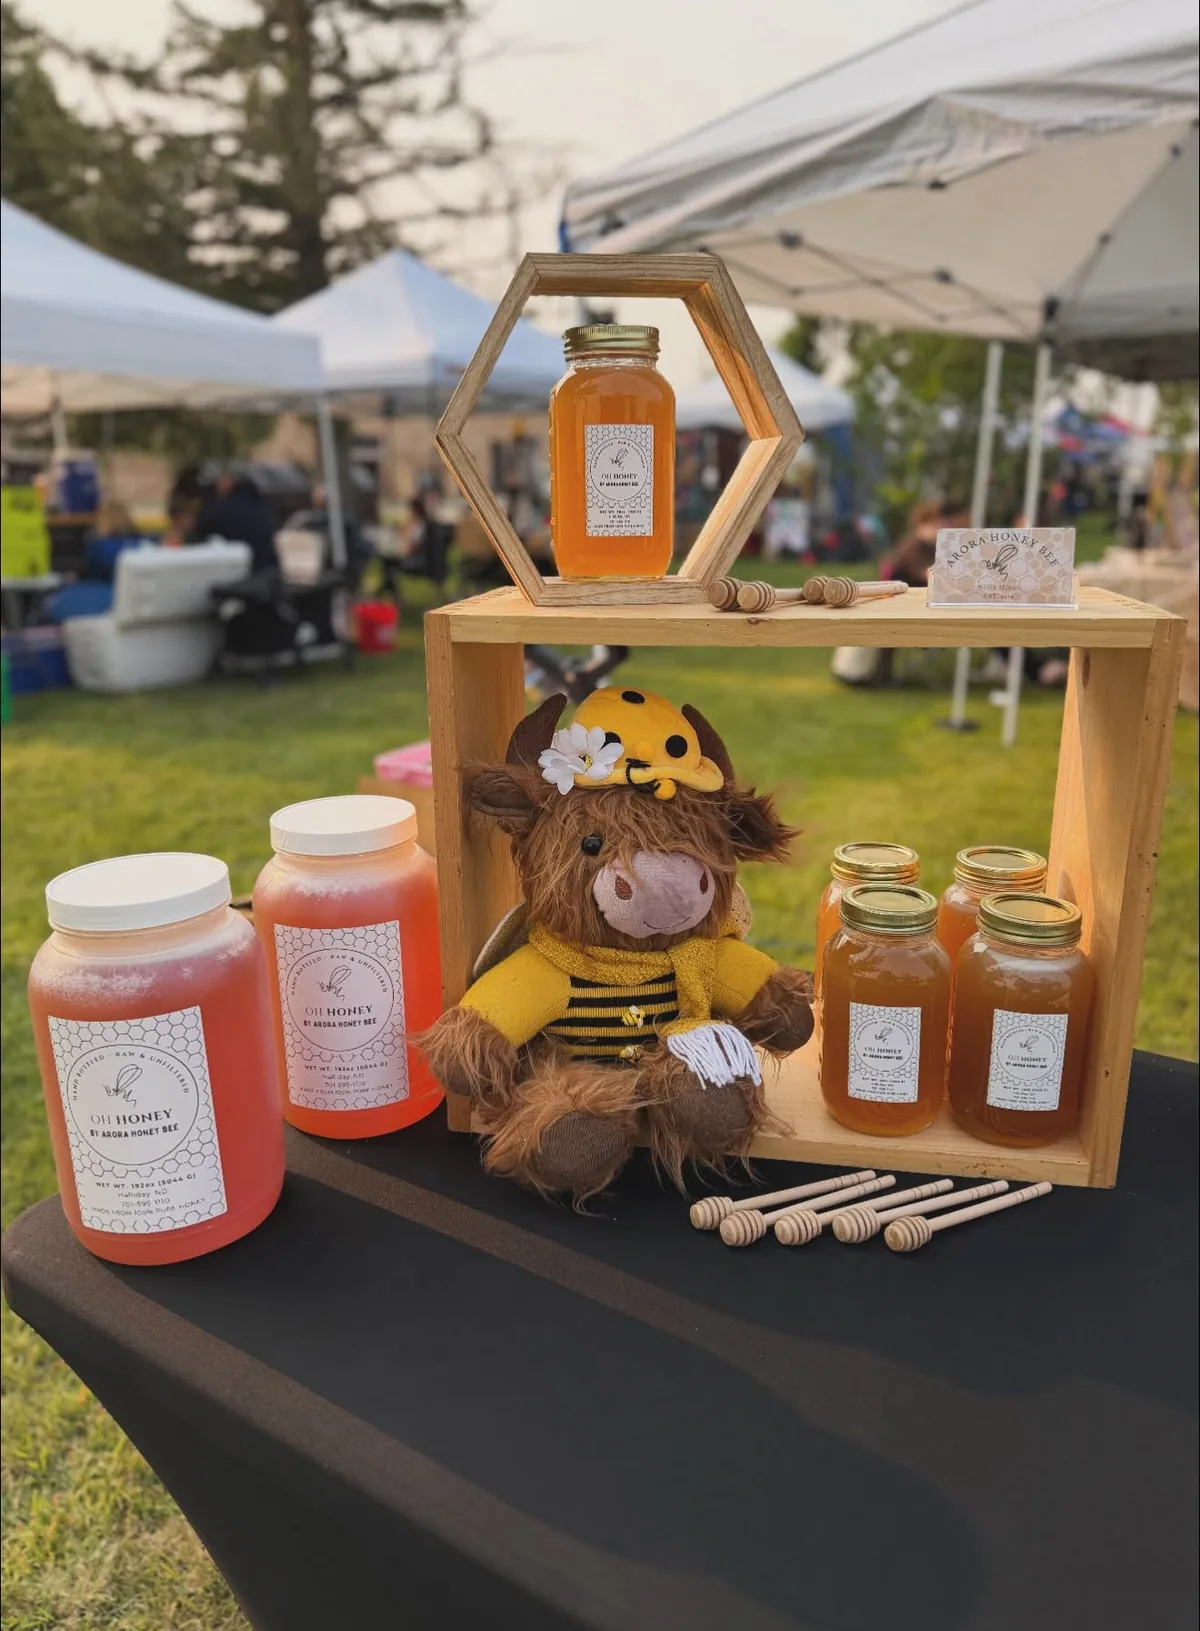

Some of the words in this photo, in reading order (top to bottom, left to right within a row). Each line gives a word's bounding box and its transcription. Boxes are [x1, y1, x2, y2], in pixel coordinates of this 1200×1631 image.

[947, 537, 986, 568] ARORA
[990, 532, 1038, 548] HONEY
[1038, 546, 1060, 568] BEE
[304, 1007, 322, 1016] OH
[327, 1005, 372, 1016] HONEY
[150, 1056, 190, 1094] UNFILTERED
[90, 1114, 112, 1125] OH
[116, 1108, 172, 1125] HONEY
[131, 1127, 159, 1137] HONEY
[162, 1123, 179, 1133] BEE
